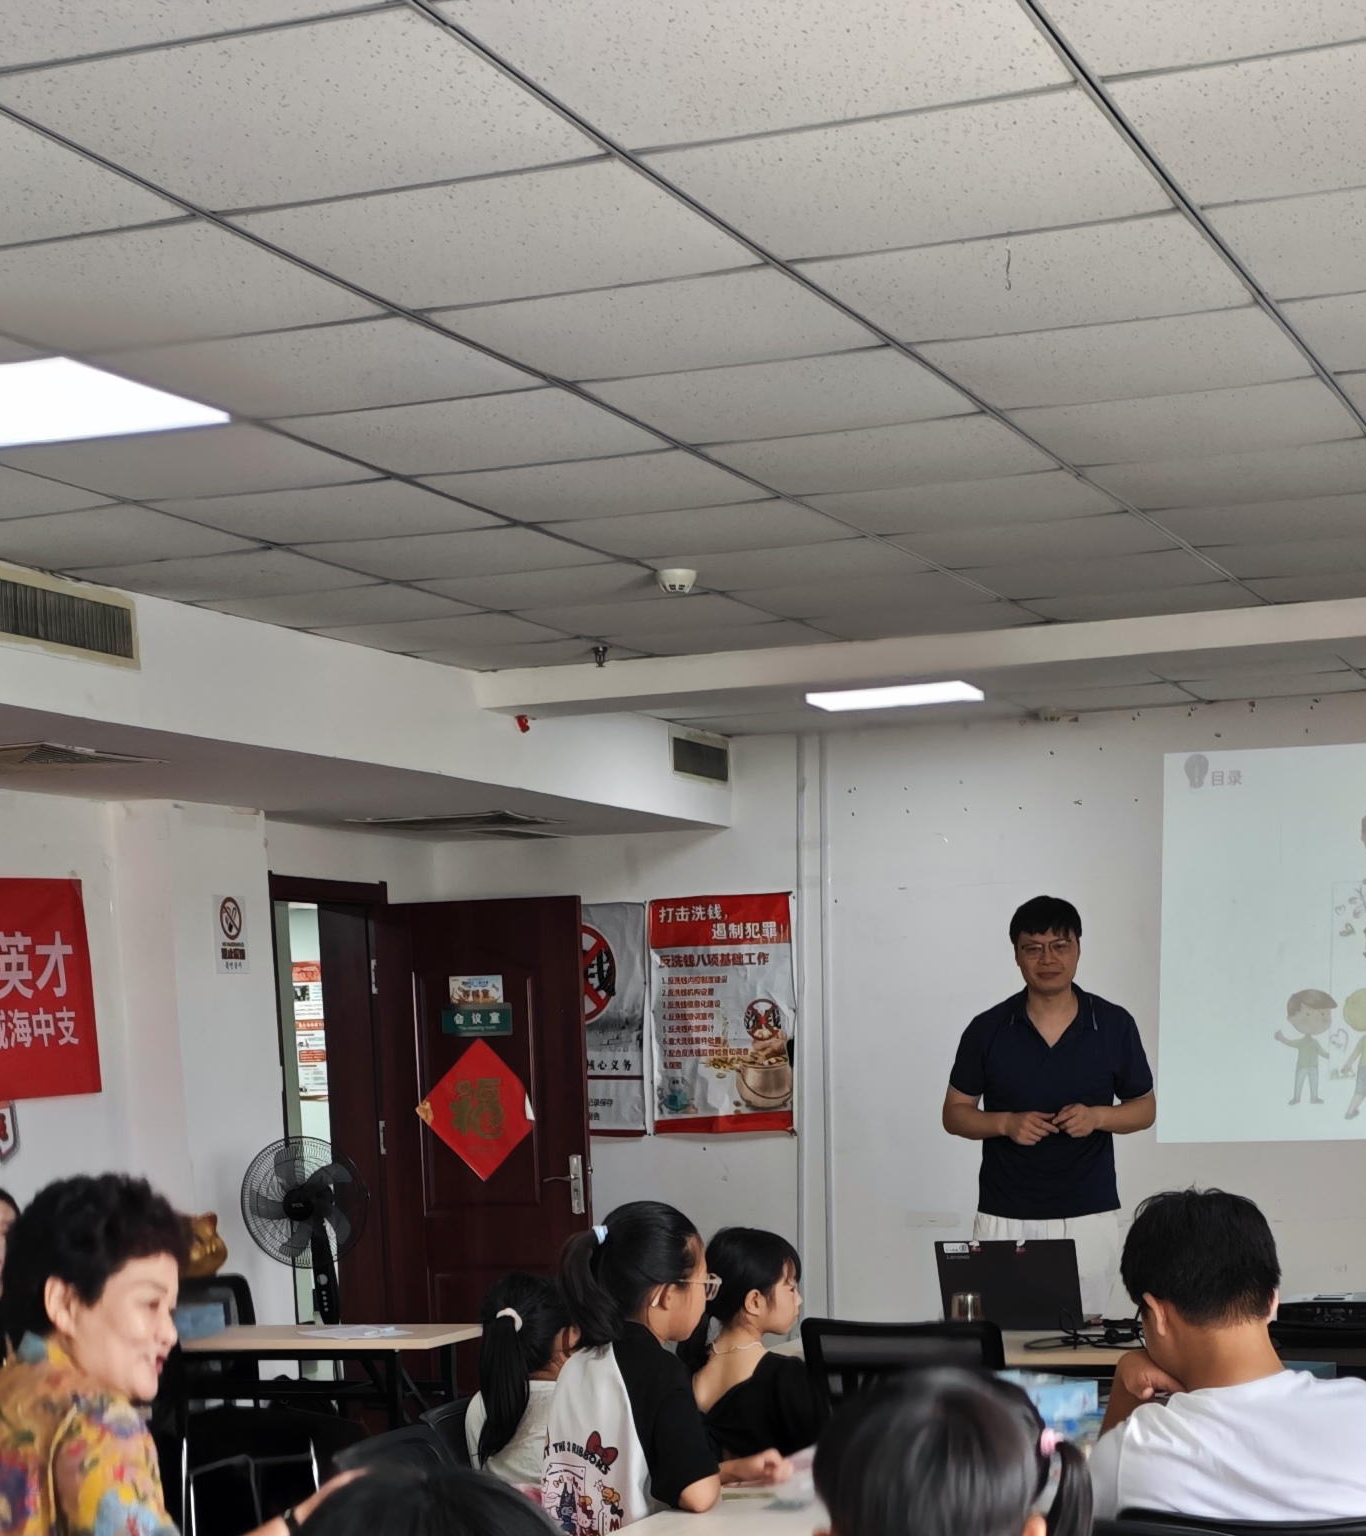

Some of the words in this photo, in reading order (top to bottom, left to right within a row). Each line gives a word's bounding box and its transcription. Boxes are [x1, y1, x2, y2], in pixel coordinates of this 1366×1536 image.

[1211, 771, 1242, 786] 目录
[712, 921, 777, 940] 遏制犯罪
[659, 952, 769, 968] 反洗钱八项基础工作
[453, 1011, 501, 1025] 会议室
[449, 1078, 506, 1139] 福
[552, 1441, 566, 1453] THE
